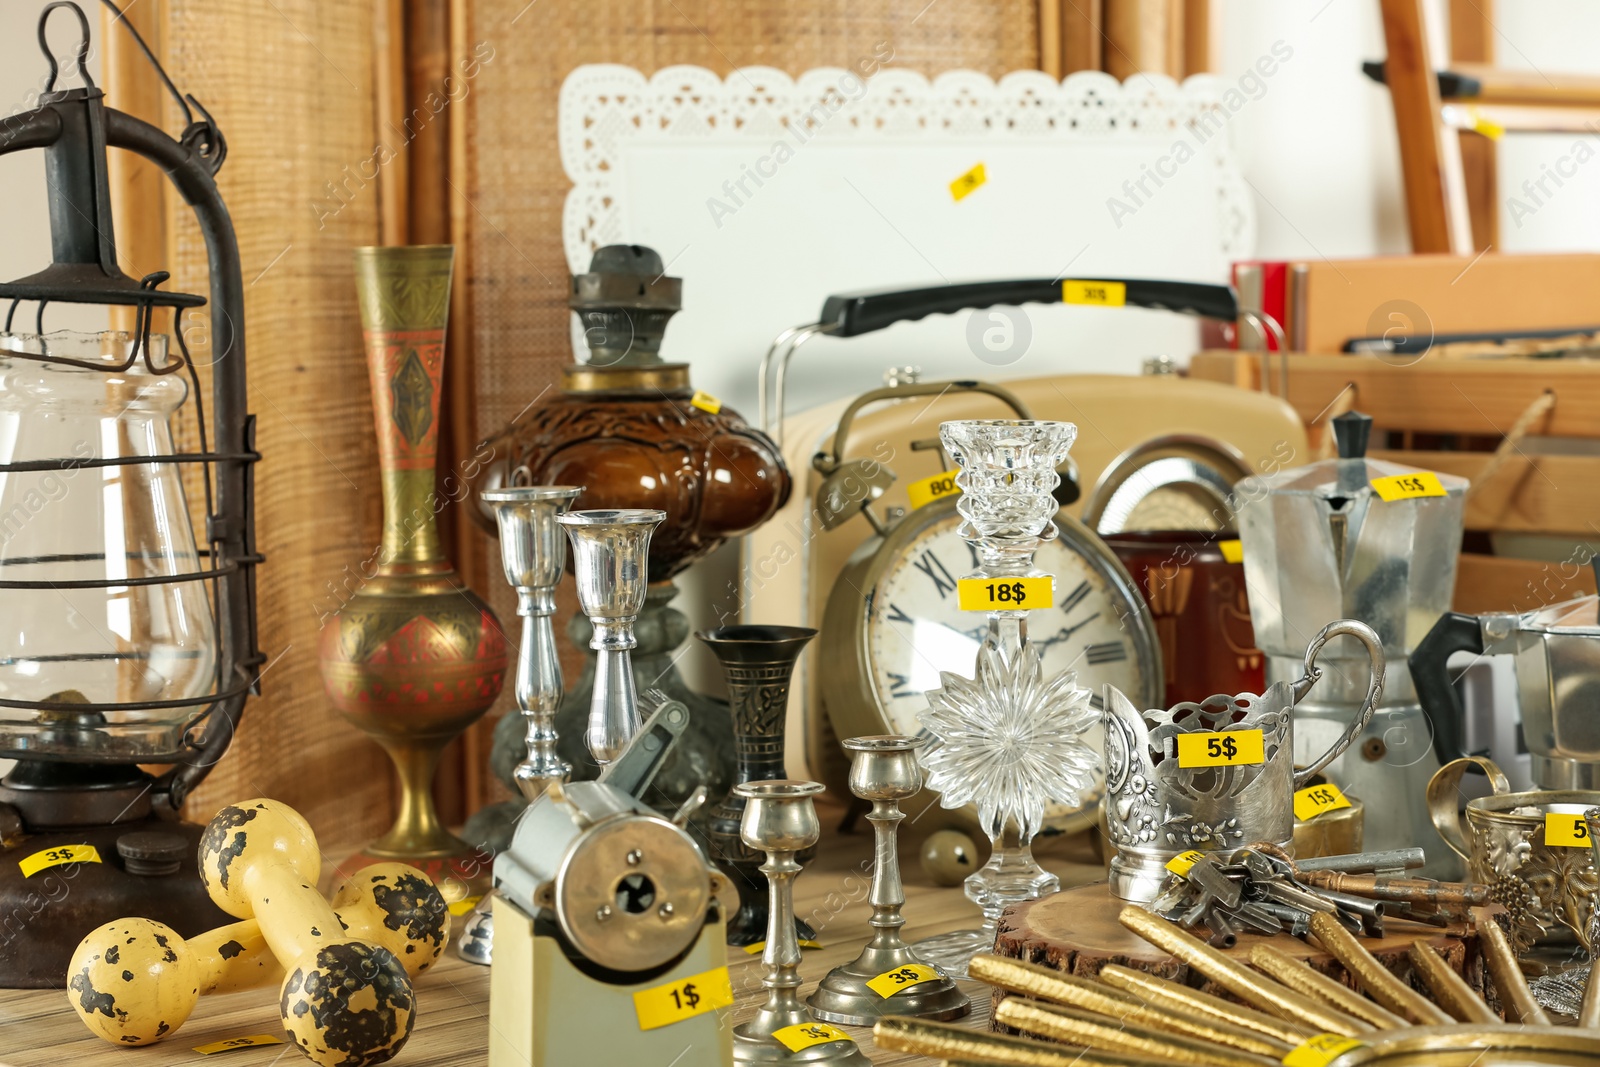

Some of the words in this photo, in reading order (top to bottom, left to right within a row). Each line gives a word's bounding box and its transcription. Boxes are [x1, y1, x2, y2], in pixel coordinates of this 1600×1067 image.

[930, 478, 956, 495] 80
[1395, 477, 1425, 492] 15$
[913, 547, 957, 599] XI
[986, 582, 1026, 605] 18$
[1207, 736, 1238, 760] 5$
[1307, 788, 1336, 805] 15$
[1573, 820, 1590, 839] 5
[45, 848, 75, 861] 3$
[889, 968, 919, 984] 3$
[669, 982, 700, 1010] 1$
[800, 1026, 830, 1039] 3$
